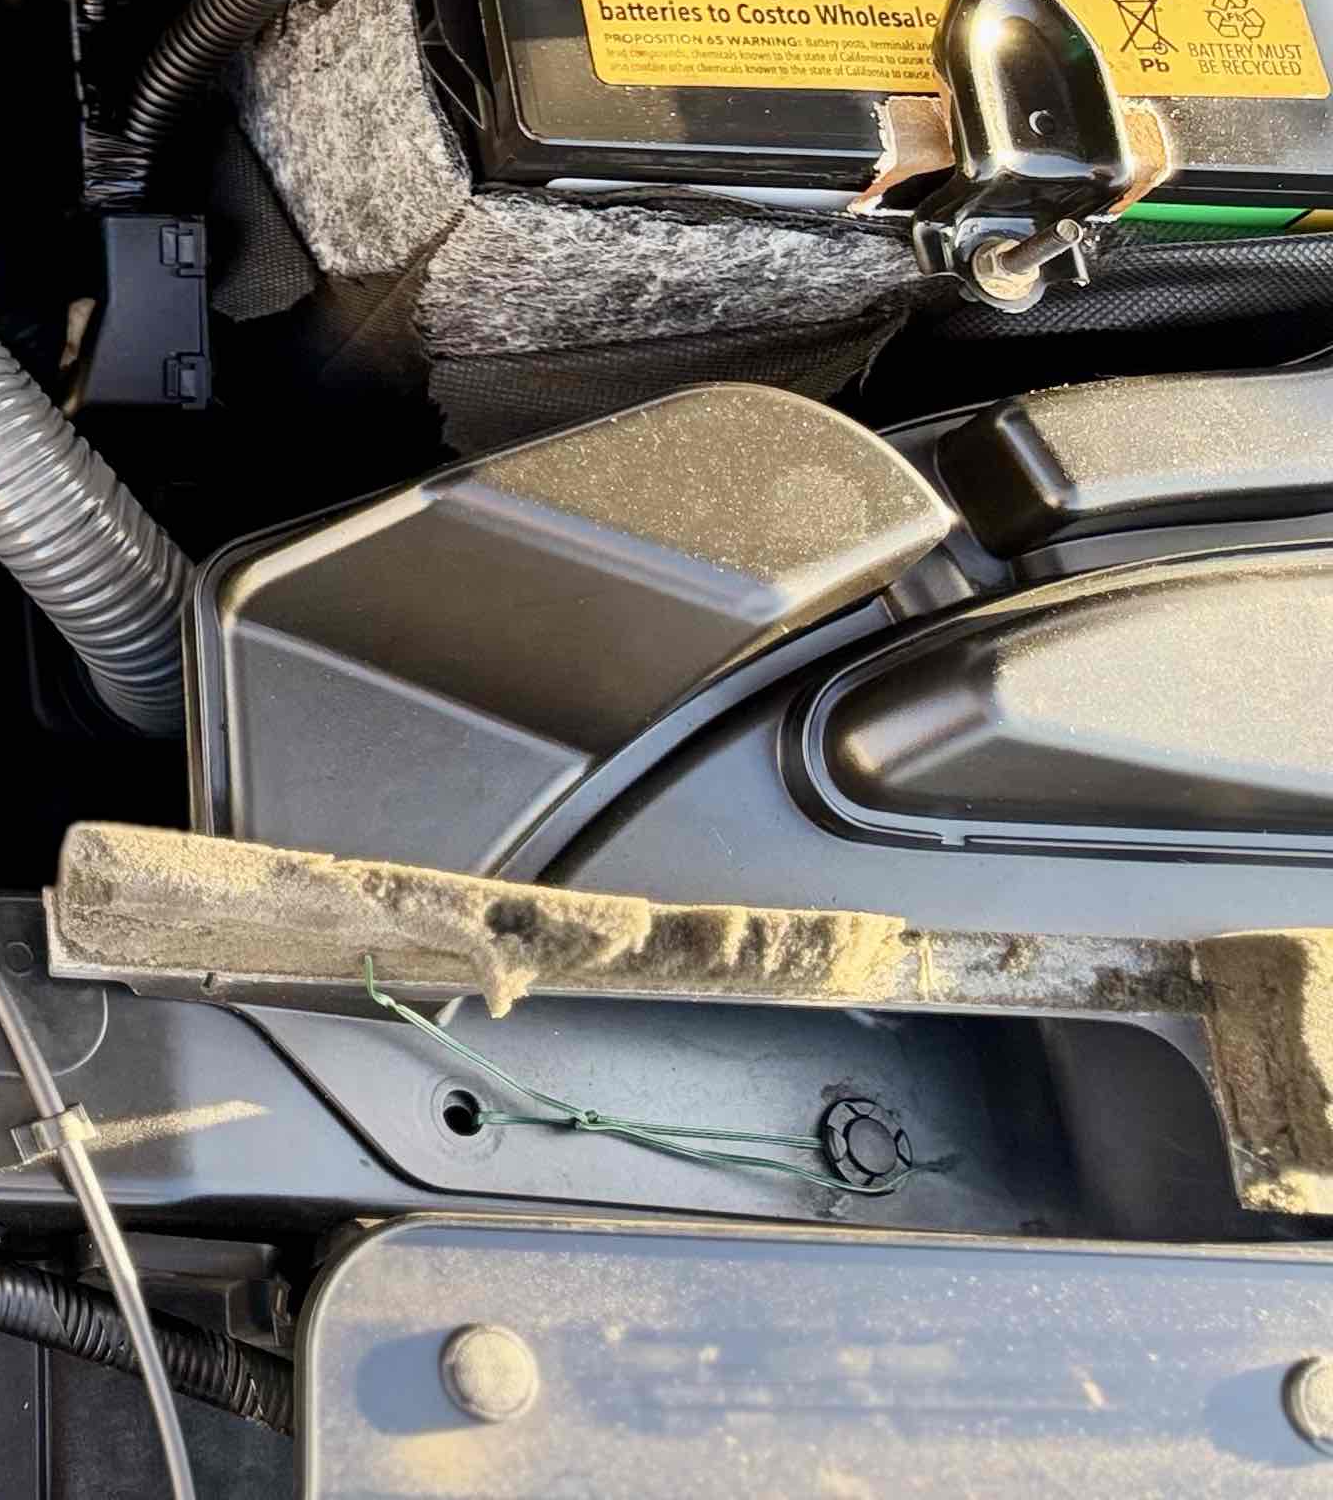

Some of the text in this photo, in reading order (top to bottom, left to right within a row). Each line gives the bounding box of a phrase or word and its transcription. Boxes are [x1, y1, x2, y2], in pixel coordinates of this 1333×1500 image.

[598, 0, 940, 28] batteries to Costco Wholesale
[604, 33, 703, 46] PROPOSITION
[1187, 43, 1302, 60] BATTERY MUST
[1140, 58, 1170, 73] Pb
[1198, 59, 1302, 77] BE RECYCLED
